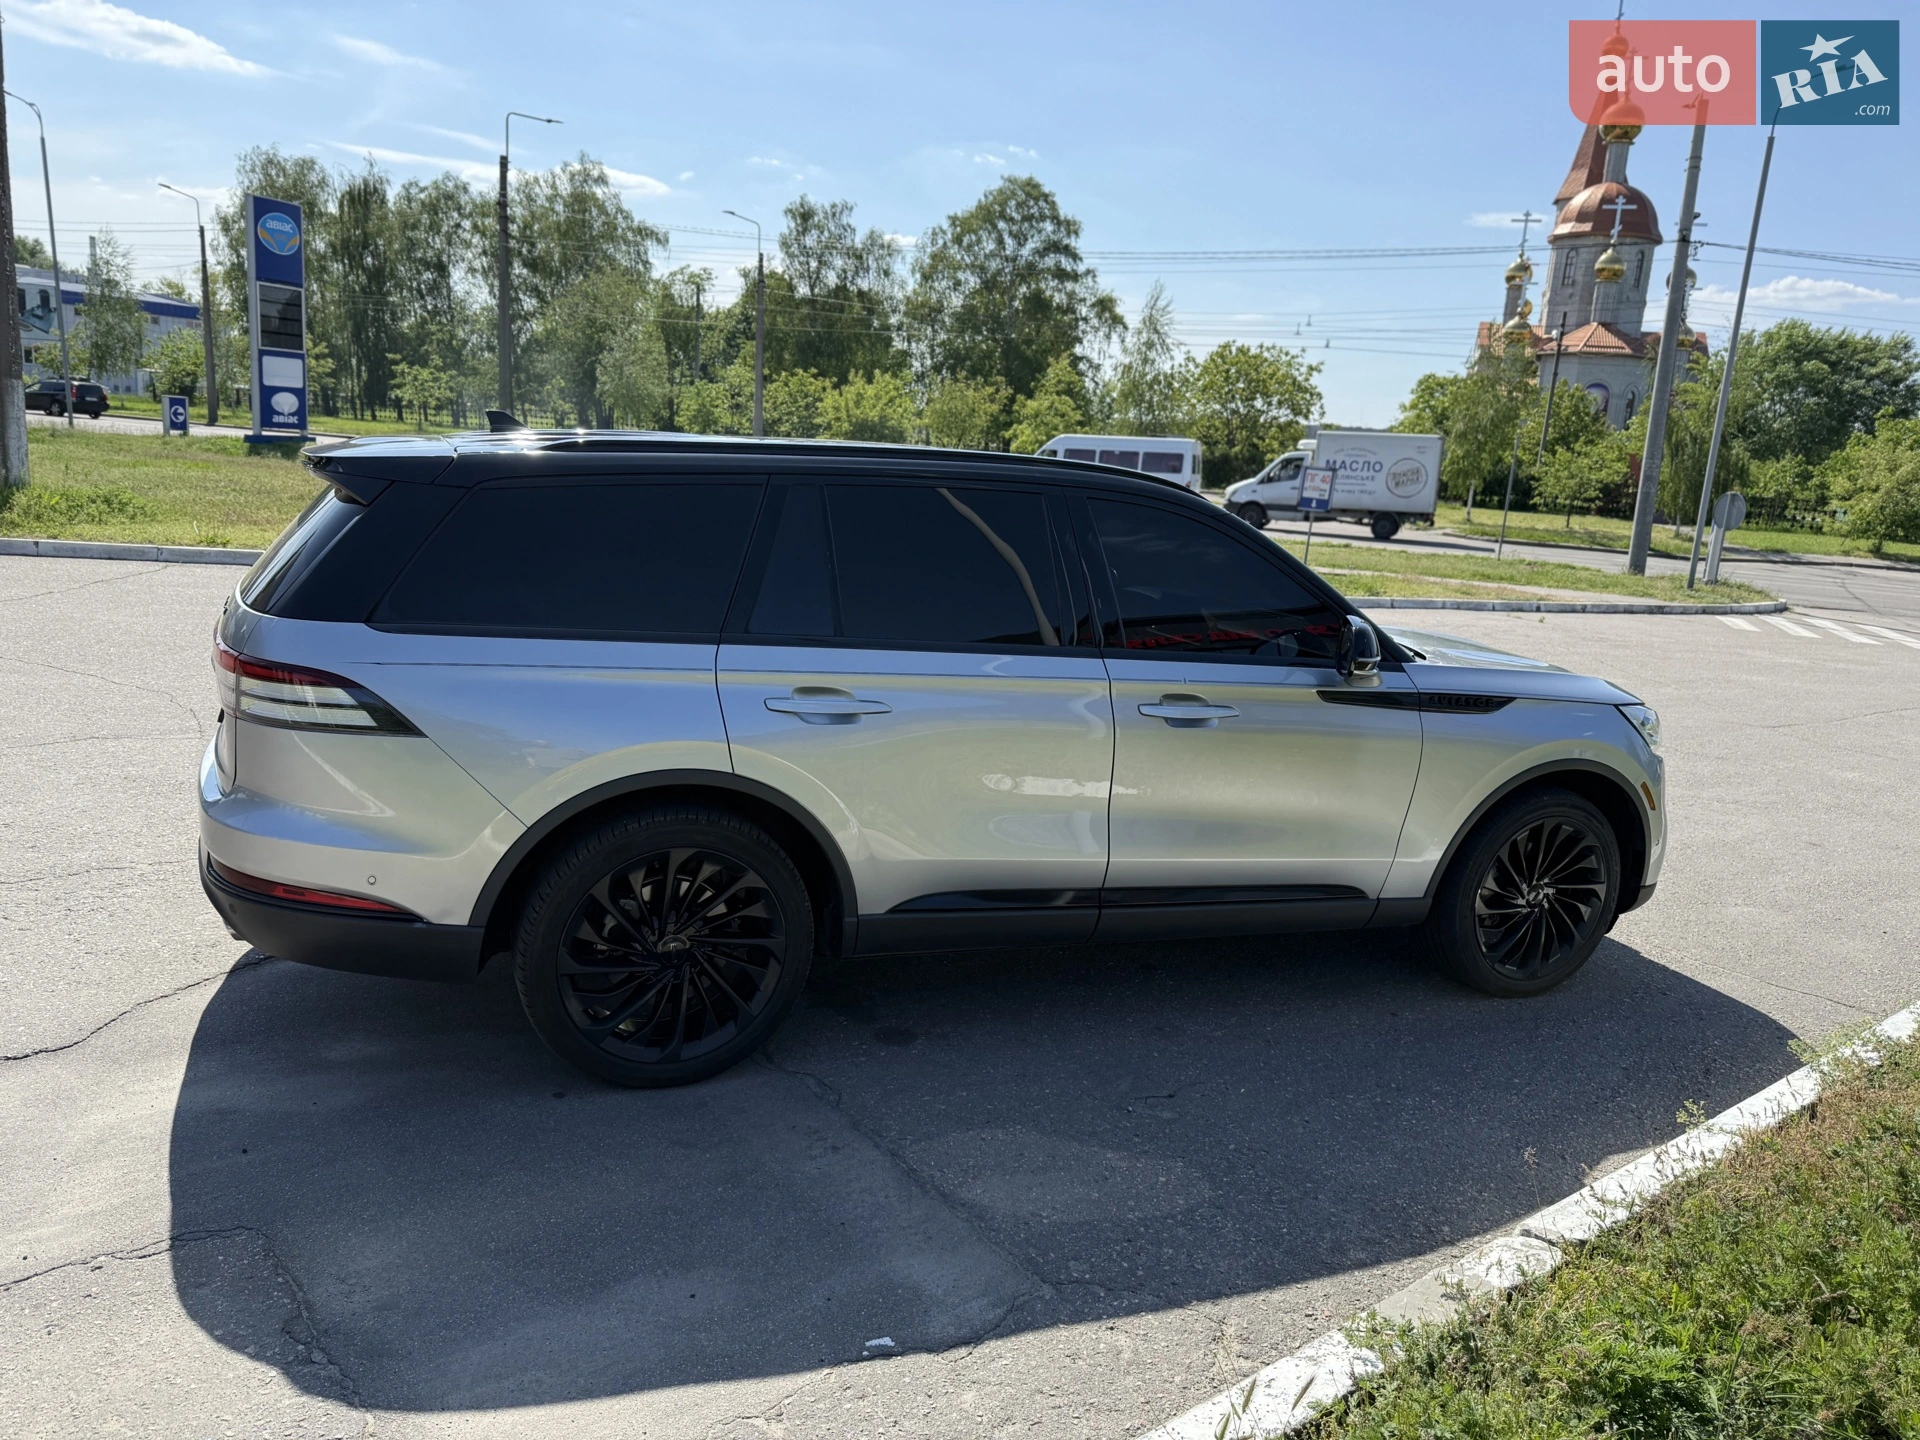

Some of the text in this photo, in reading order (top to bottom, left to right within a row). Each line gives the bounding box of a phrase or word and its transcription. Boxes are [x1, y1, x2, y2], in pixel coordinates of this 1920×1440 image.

[1325, 459, 1383, 473] МАСЛО
[1320, 474, 1331, 485] 40
[1335, 474, 1376, 482] ЕЛЯНСЬКЕ
[1429, 695, 1495, 707] AVIATOR
